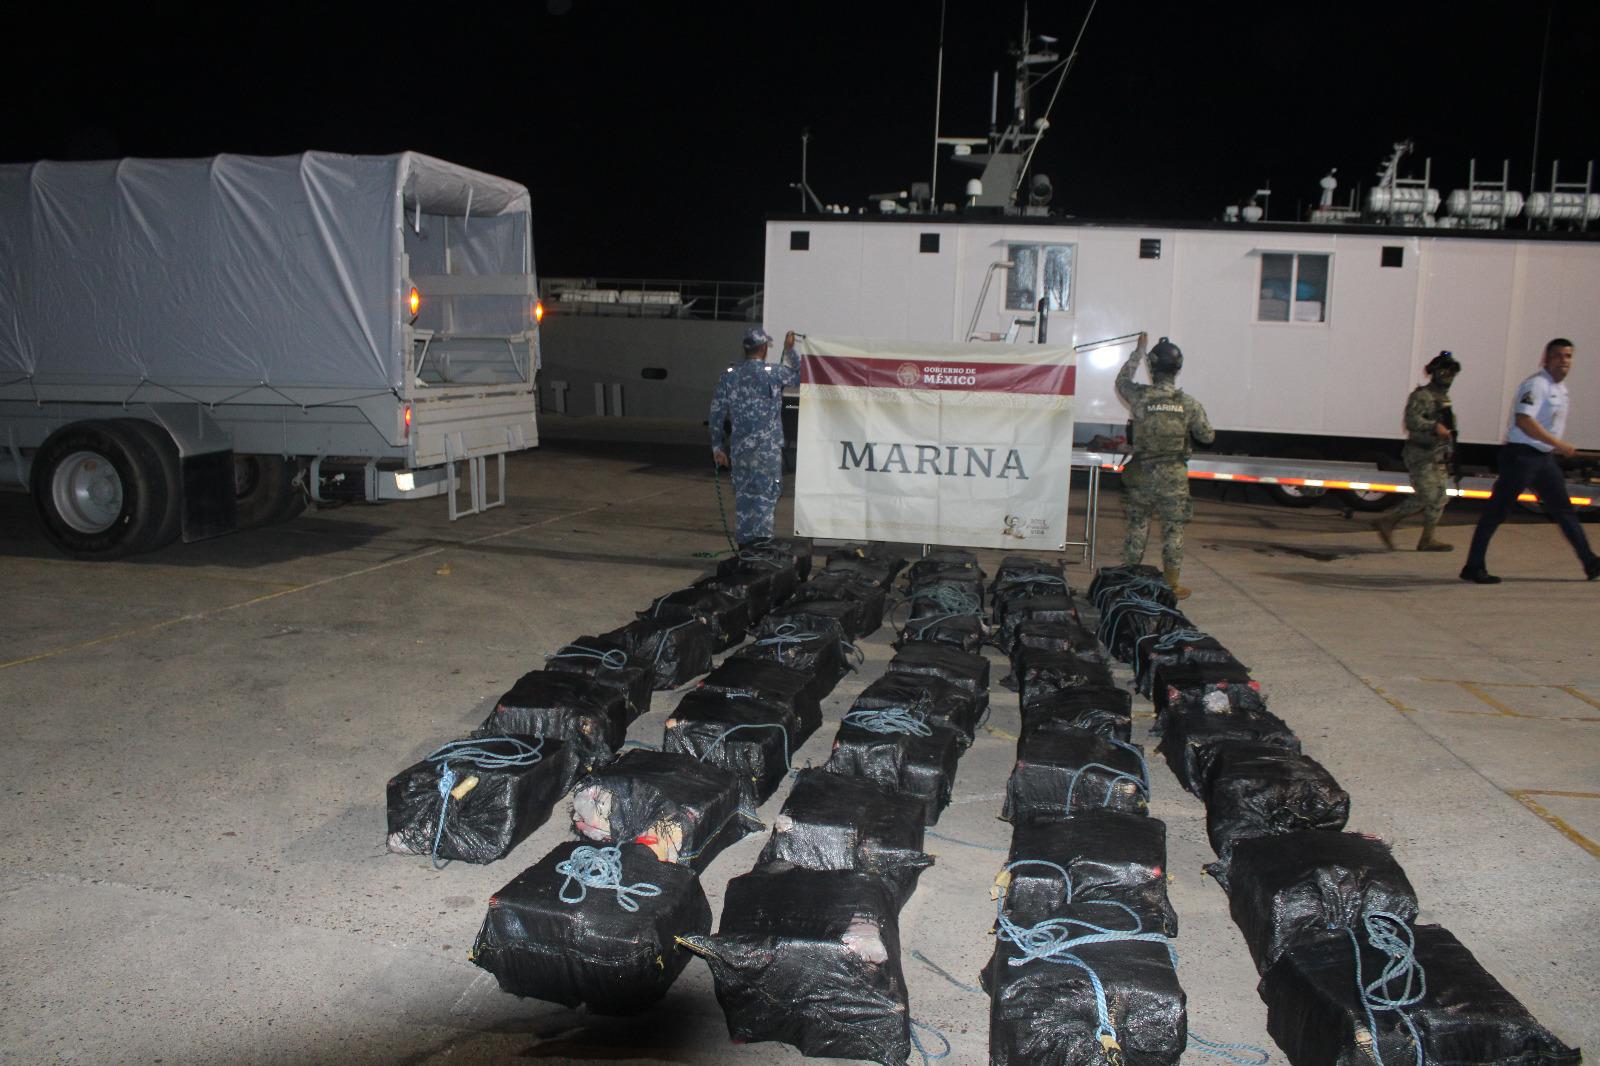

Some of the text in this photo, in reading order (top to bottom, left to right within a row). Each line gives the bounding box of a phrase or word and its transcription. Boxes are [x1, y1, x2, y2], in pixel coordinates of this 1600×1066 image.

[923, 366, 964, 374] GOBIERNO
[923, 373, 976, 385] MÉXICO
[1147, 403, 1184, 413] MARINA
[838, 440, 1029, 480] MARINA
